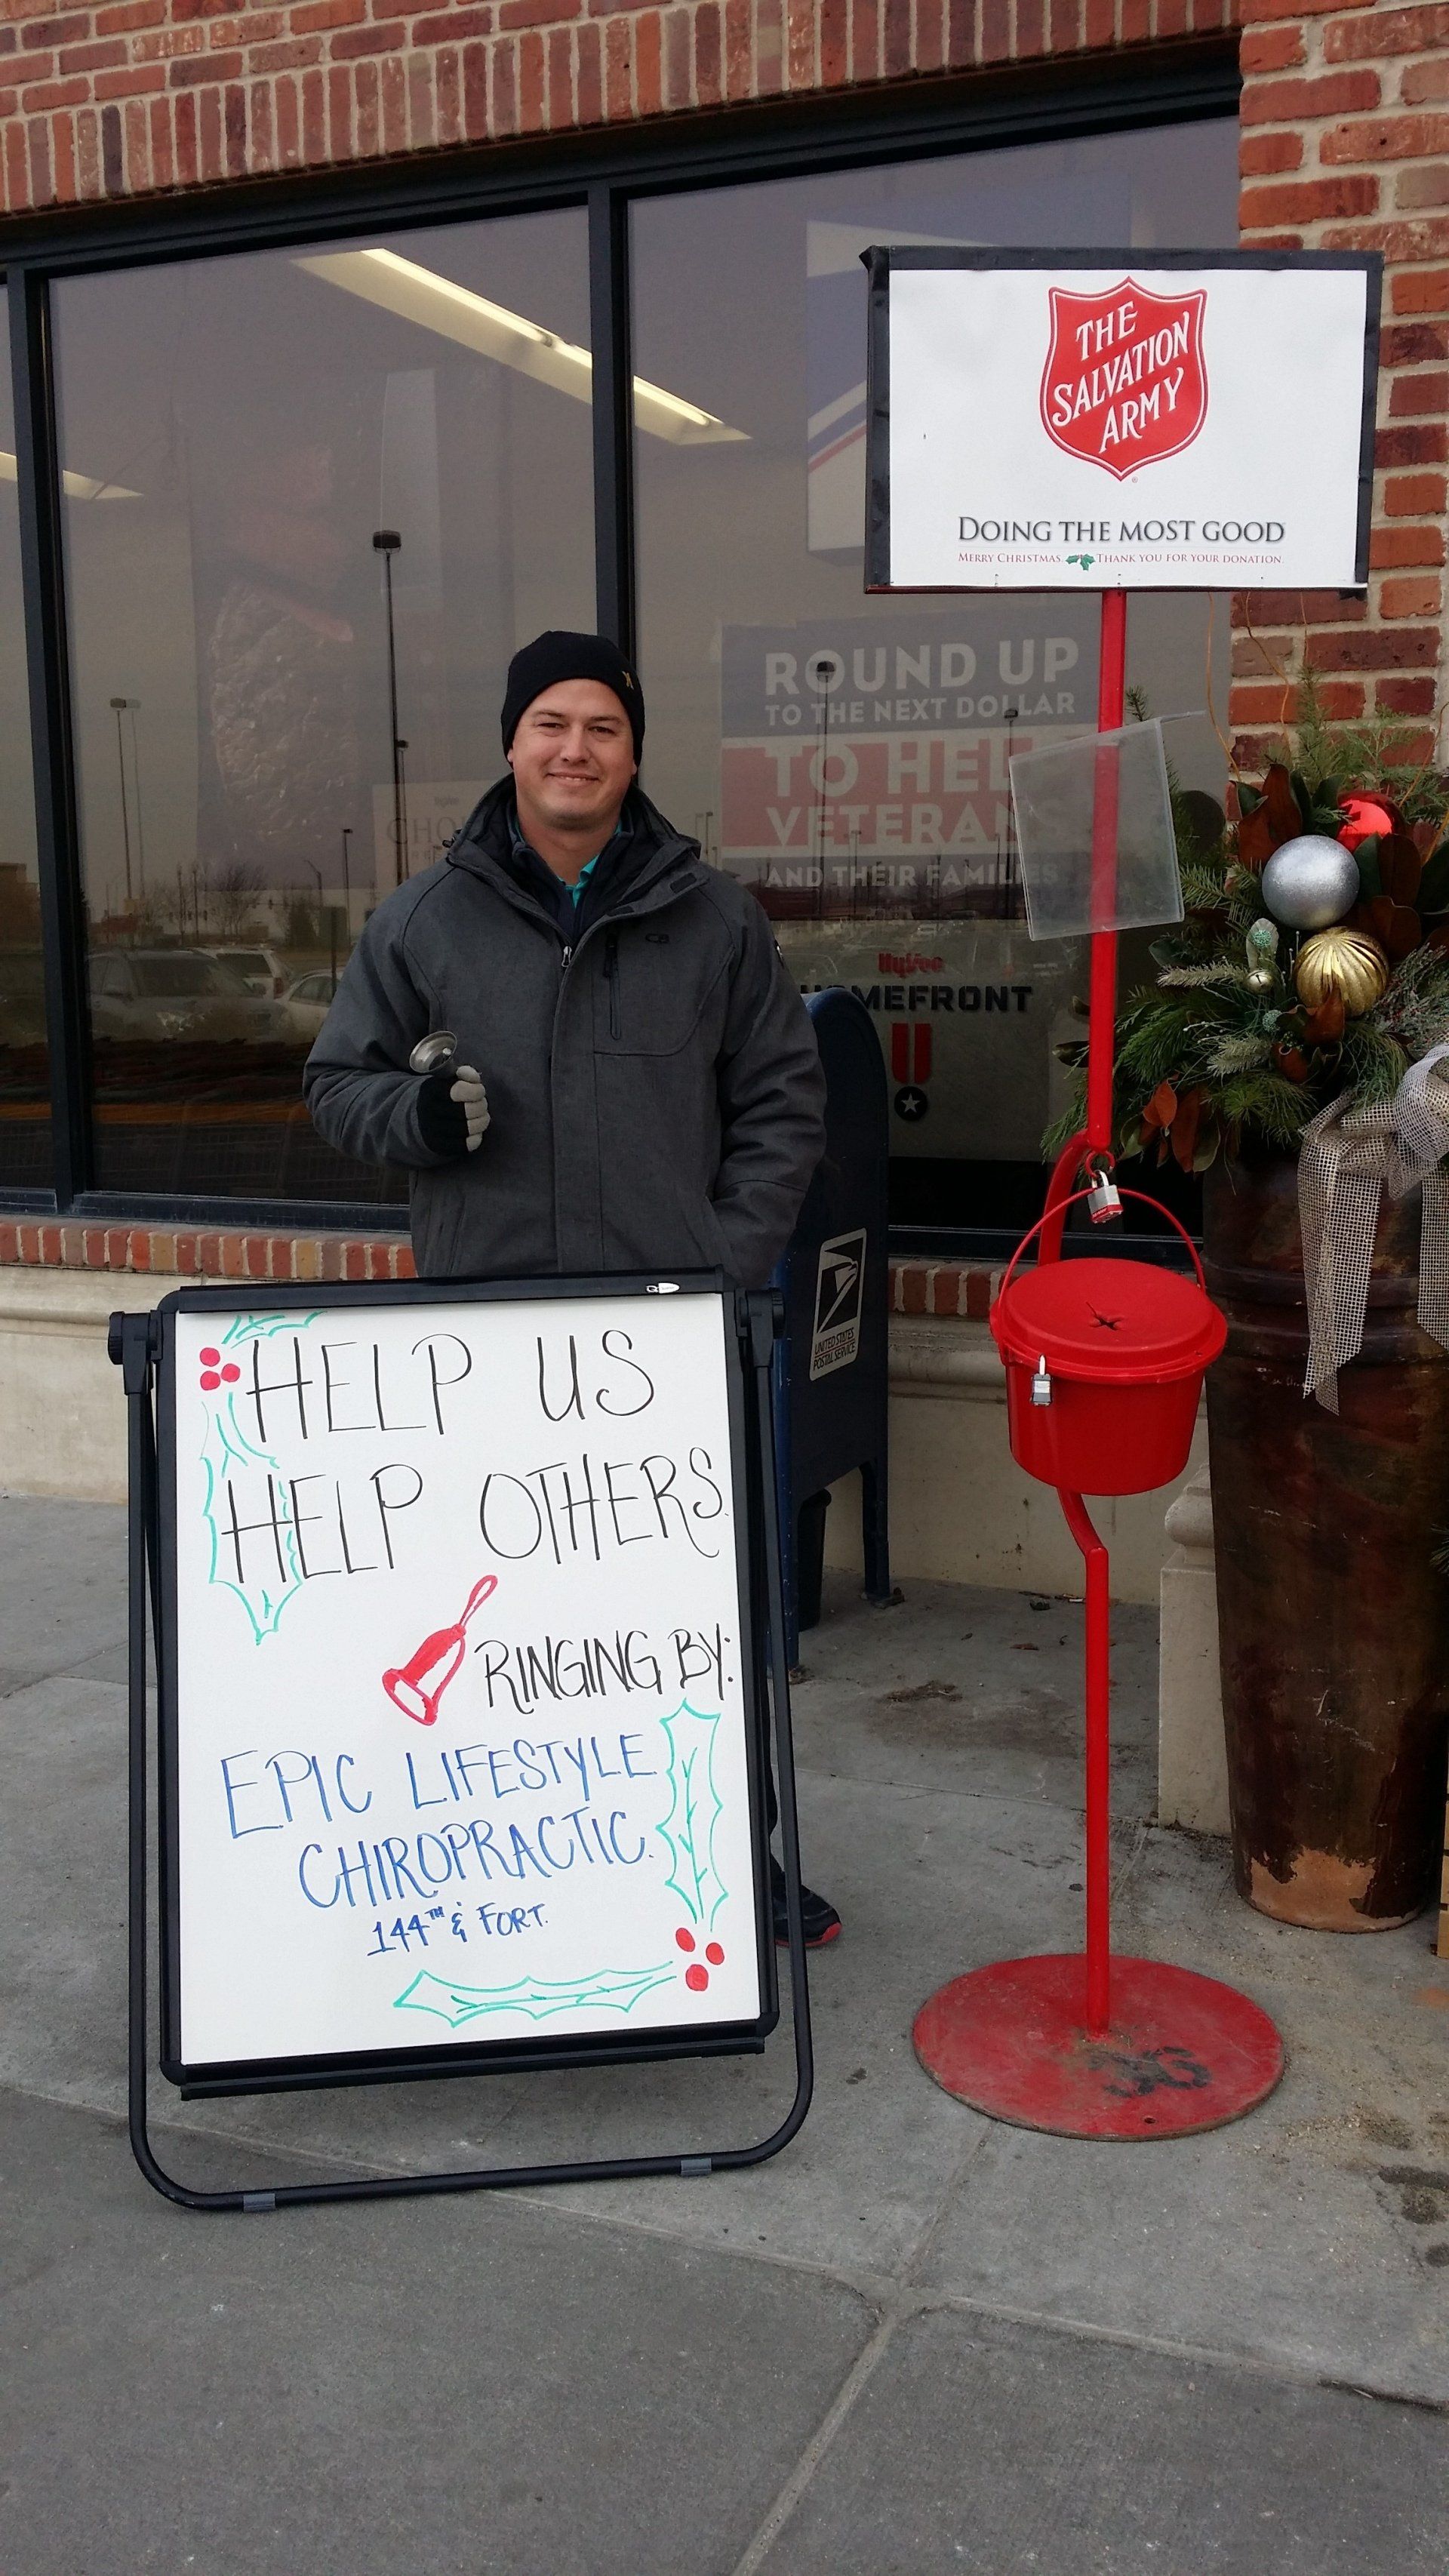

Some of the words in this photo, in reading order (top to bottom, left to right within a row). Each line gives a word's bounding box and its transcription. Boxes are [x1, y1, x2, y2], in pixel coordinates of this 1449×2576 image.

[1075, 300, 1138, 362] THE
[1052, 311, 1190, 427] SALVATION
[1098, 366, 1184, 454] ARMY
[958, 516, 1052, 542] DOING
[1057, 520, 1111, 542] THE
[1119, 519, 1195, 542] MOST
[1201, 520, 1285, 543] GOOD
[958, 552, 994, 564] MERRY
[1097, 553, 1136, 564] THANK
[1138, 553, 1162, 563] YOU
[1166, 553, 1187, 562] FOR
[1190, 554, 1220, 564] YOUR
[764, 642, 977, 696] ROUND
[997, 636, 1080, 684] UP
[764, 703, 801, 727] TO
[811, 700, 865, 725] THE
[873, 696, 947, 722] NEXT
[955, 691, 1075, 718] DOLLAR
[764, 743, 860, 797] TO
[888, 735, 1013, 792] HEL
[764, 802, 1017, 847] VETERAN
[764, 865, 824, 888] AND
[833, 863, 915, 886] THEIR
[800, 985, 1032, 1011] MEFRONT
[813, 1351, 834, 1371] POSTAL
[835, 1341, 856, 1361] SERVICE
[814, 1335, 835, 1356] UNITED
[836, 1327, 855, 1345] STATES
[246, 1332, 472, 1442] HELP
[535, 1328, 655, 1422] US
[221, 1463, 424, 1583] HELP
[473, 1628, 663, 1715] RINGING
[673, 1623, 734, 1700] BY:
[220, 1750, 373, 1839] EPIC
[406, 1733, 658, 1810] LIFESTYLE
[299, 1806, 654, 1910] CHIROPRACTIC.
